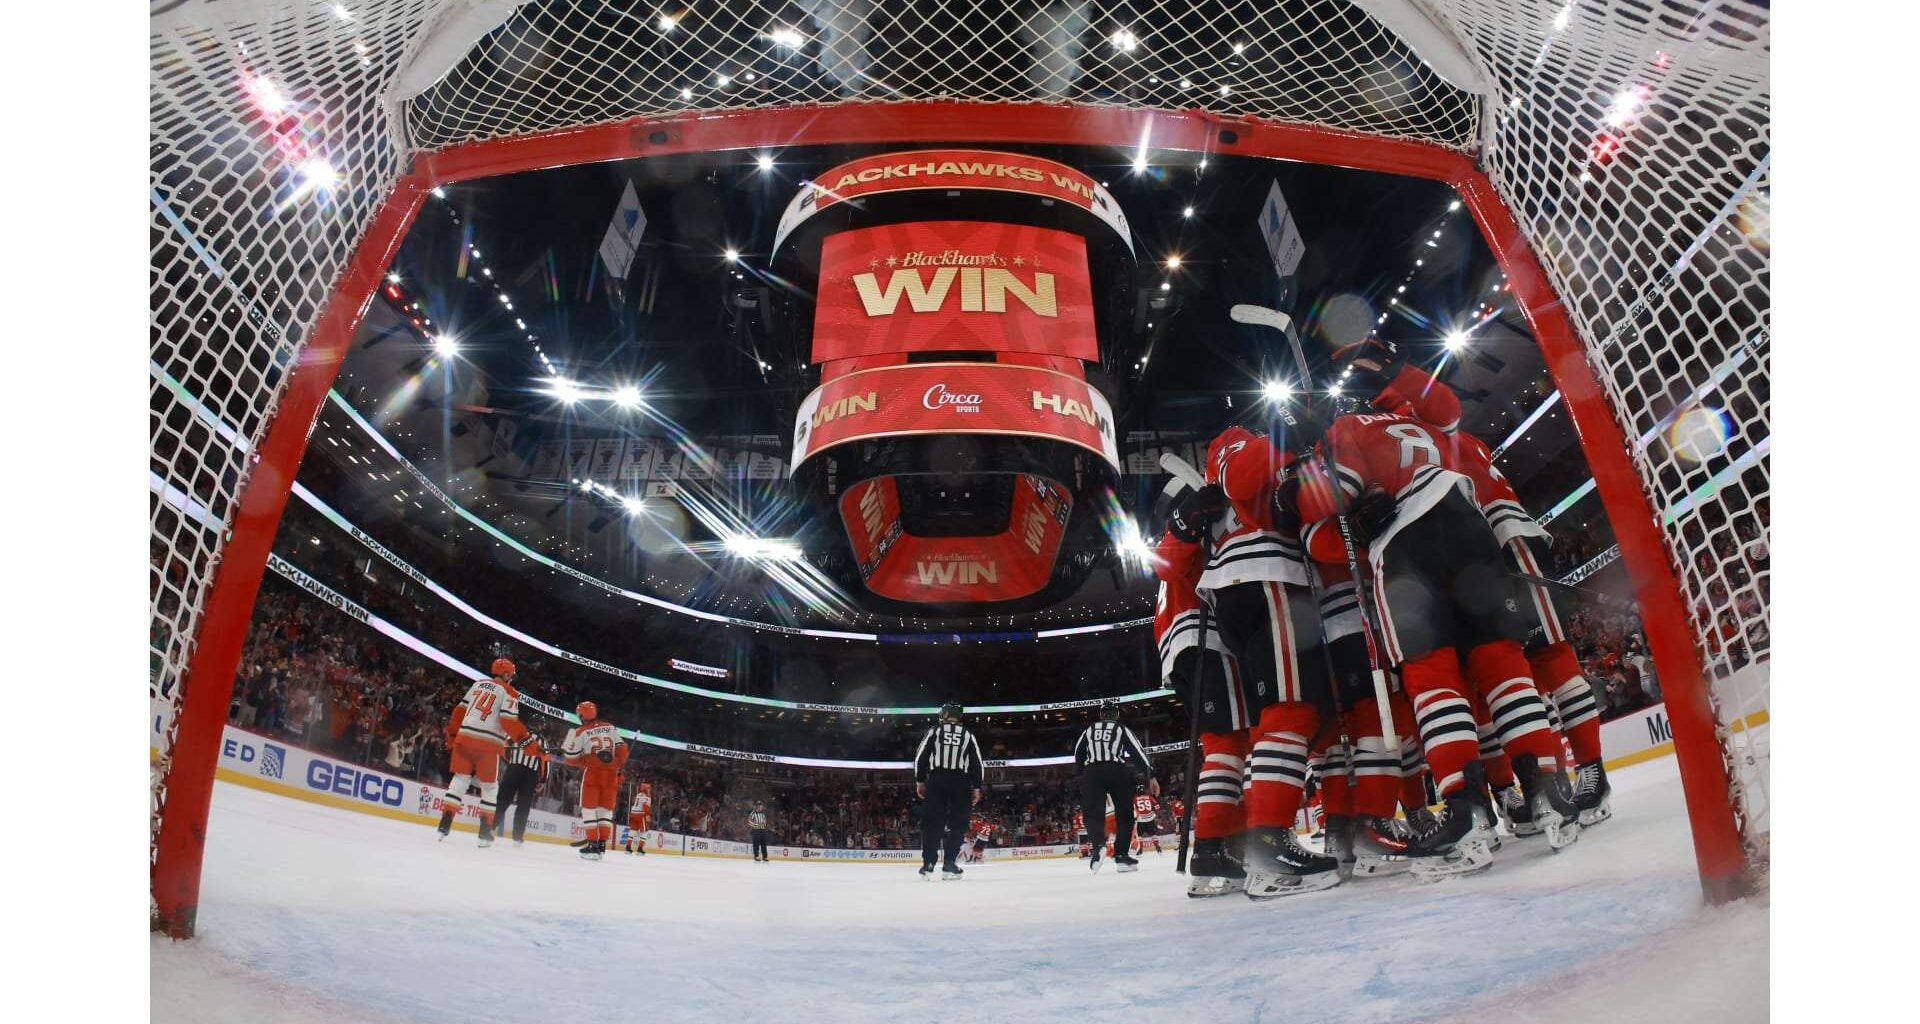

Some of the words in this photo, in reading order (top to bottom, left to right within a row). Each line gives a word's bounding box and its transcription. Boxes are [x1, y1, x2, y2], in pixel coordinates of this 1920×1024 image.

[903, 249, 1008, 267] Blackhawks
[852, 267, 1058, 318] WIN
[923, 384, 983, 410] Circa
[811, 391, 877, 429] WIN
[1385, 424, 1441, 469] 8
[350, 526, 411, 573] BLACKHAWKS
[411, 569, 427, 585] WIN
[916, 561, 998, 585] WIN
[345, 601, 369, 623] WIN
[561, 651, 620, 677] BLACKHAWKS
[621, 669, 638, 681] WIN
[466, 689, 497, 721] 74
[547, 706, 565, 718] WIN
[796, 703, 859, 714] BLACKHAWKS
[1040, 700, 1101, 711] BLACKHAWKS
[223, 739, 255, 763] ED
[943, 733, 961, 746] 55
[686, 744, 754, 760] BLACKHAWKS
[755, 753, 776, 762] WIN
[307, 759, 404, 807] GEICO
[1136, 800, 1152, 811] 59
